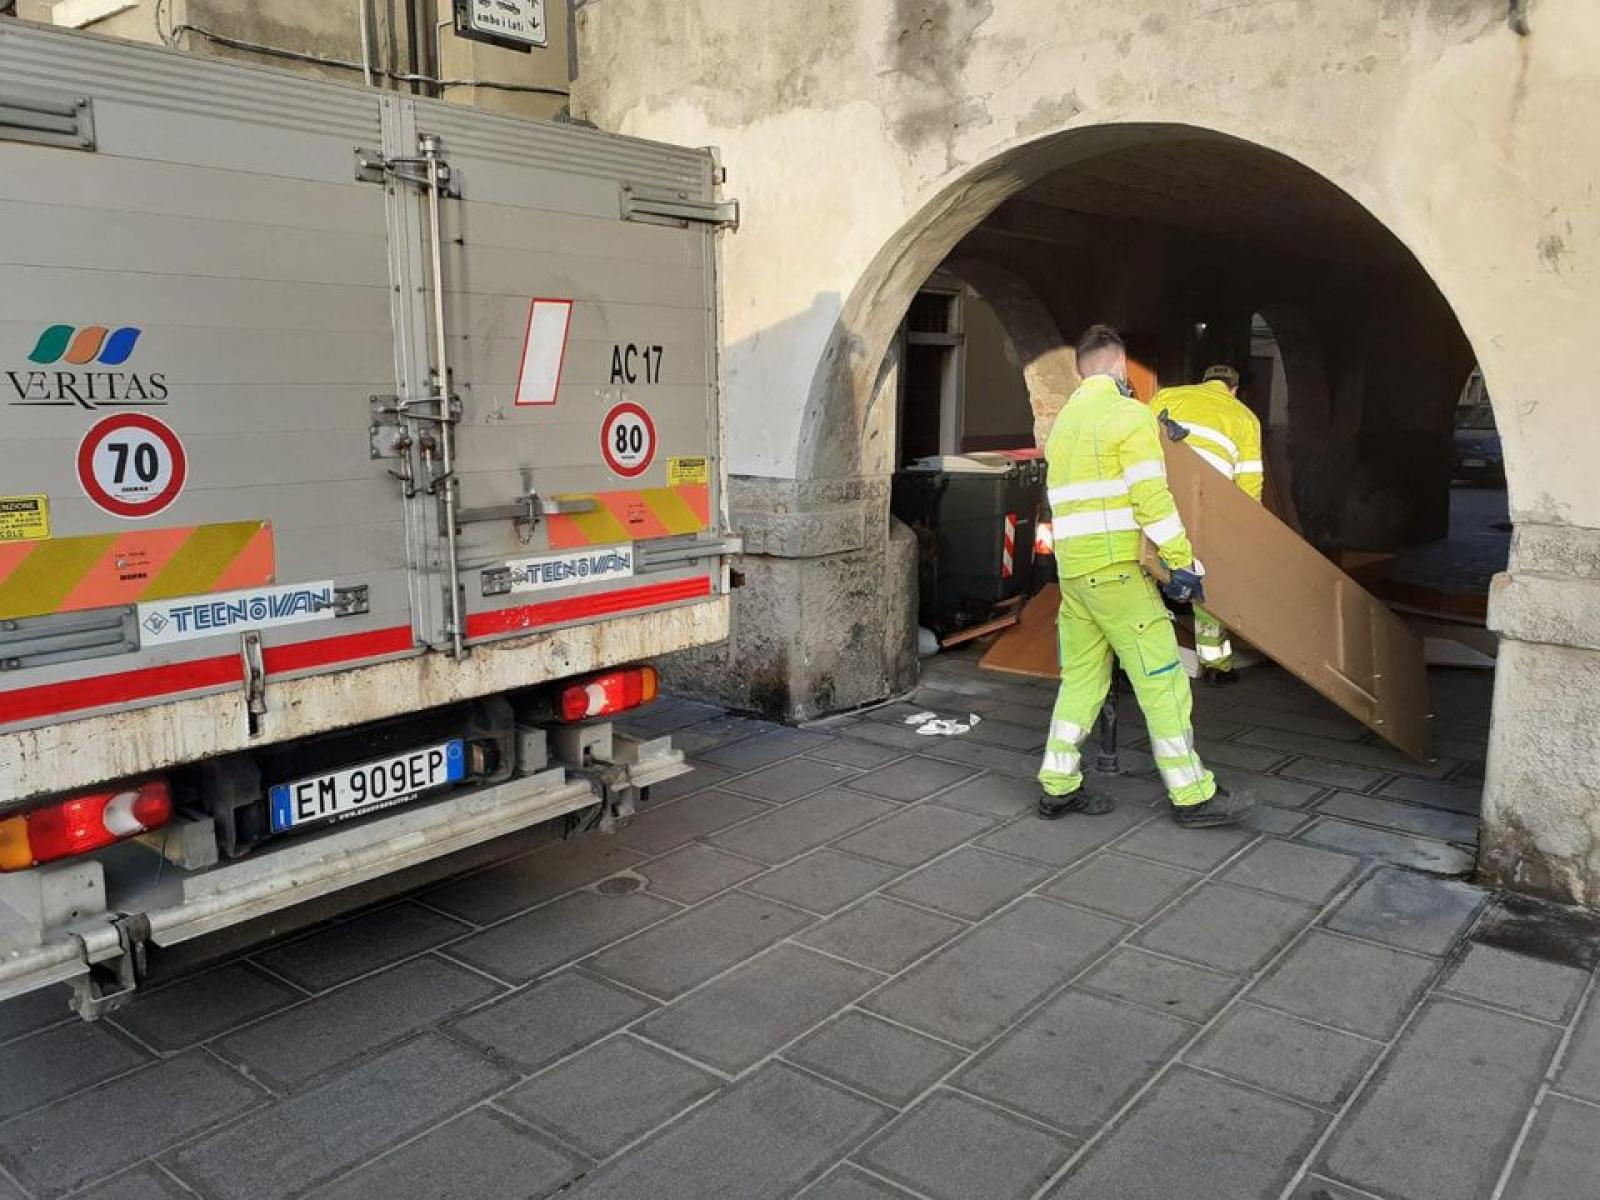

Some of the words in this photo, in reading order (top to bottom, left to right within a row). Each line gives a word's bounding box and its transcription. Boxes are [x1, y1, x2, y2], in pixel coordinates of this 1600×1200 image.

[610, 343, 638, 385] AC
[643, 344, 663, 385] 17
[5, 371, 169, 410] VERITAS
[616, 424, 643, 454] 80
[108, 442, 159, 484] 70
[527, 552, 631, 584] TECNOVAN
[170, 588, 331, 632] TECNOVAN
[296, 776, 337, 820] EM
[350, 751, 443, 805] 909EP
